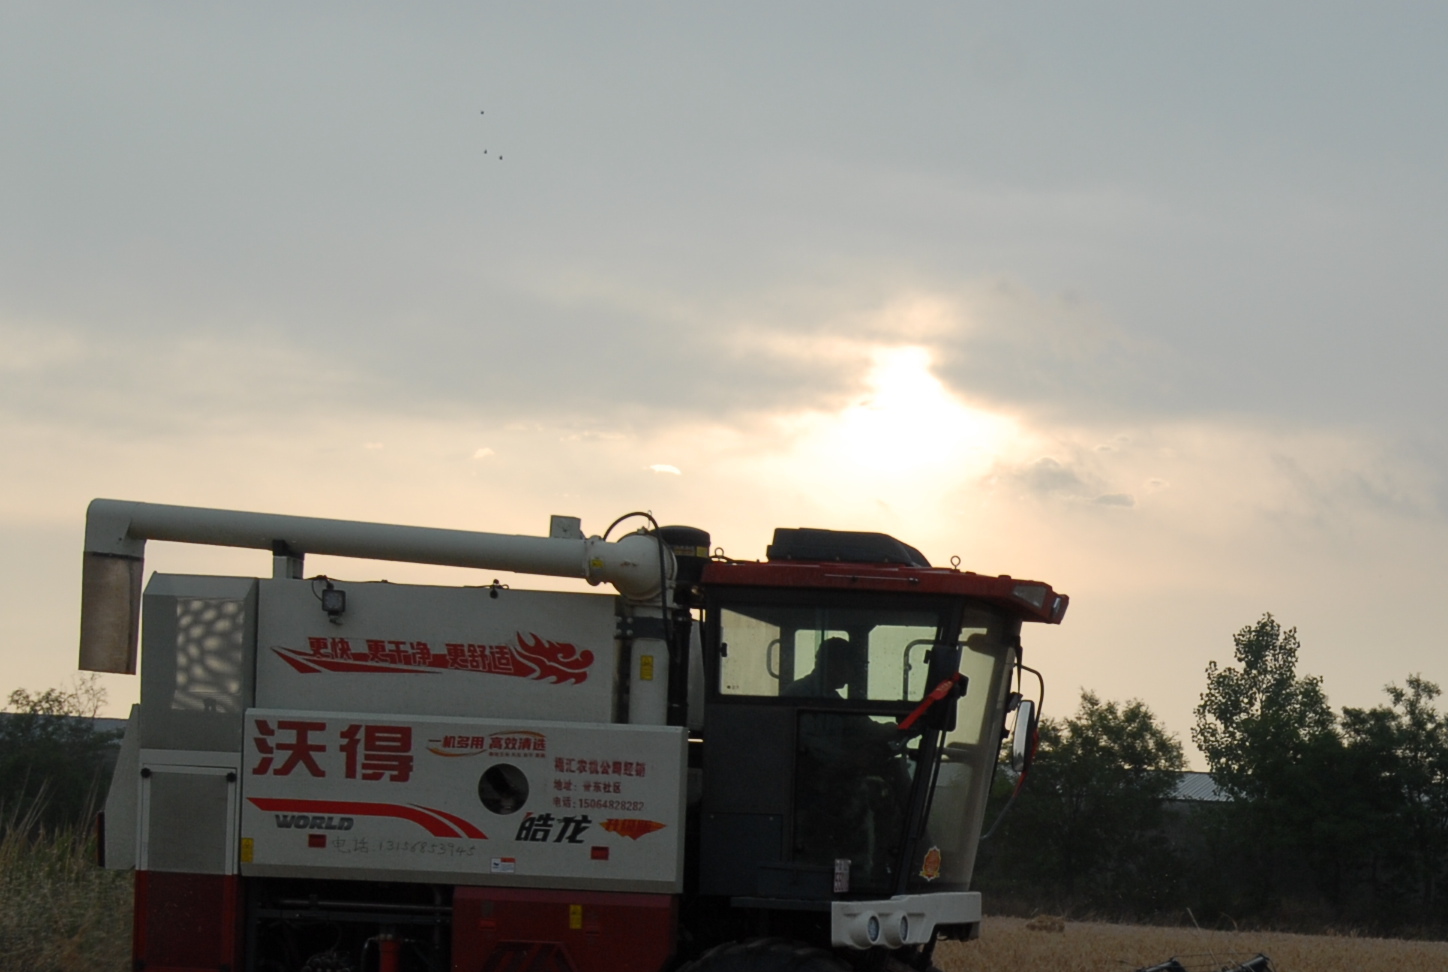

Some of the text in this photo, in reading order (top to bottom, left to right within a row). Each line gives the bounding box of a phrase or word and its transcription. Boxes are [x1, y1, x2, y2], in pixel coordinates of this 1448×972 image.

[308, 637, 514, 673] 更快 更干净 更舒适
[252, 719, 413, 783] 沃得
[428, 735, 546, 751] 一机多用 高效清选
[275, 814, 354, 831] WORLD
[515, 812, 592, 843] 皓龙
